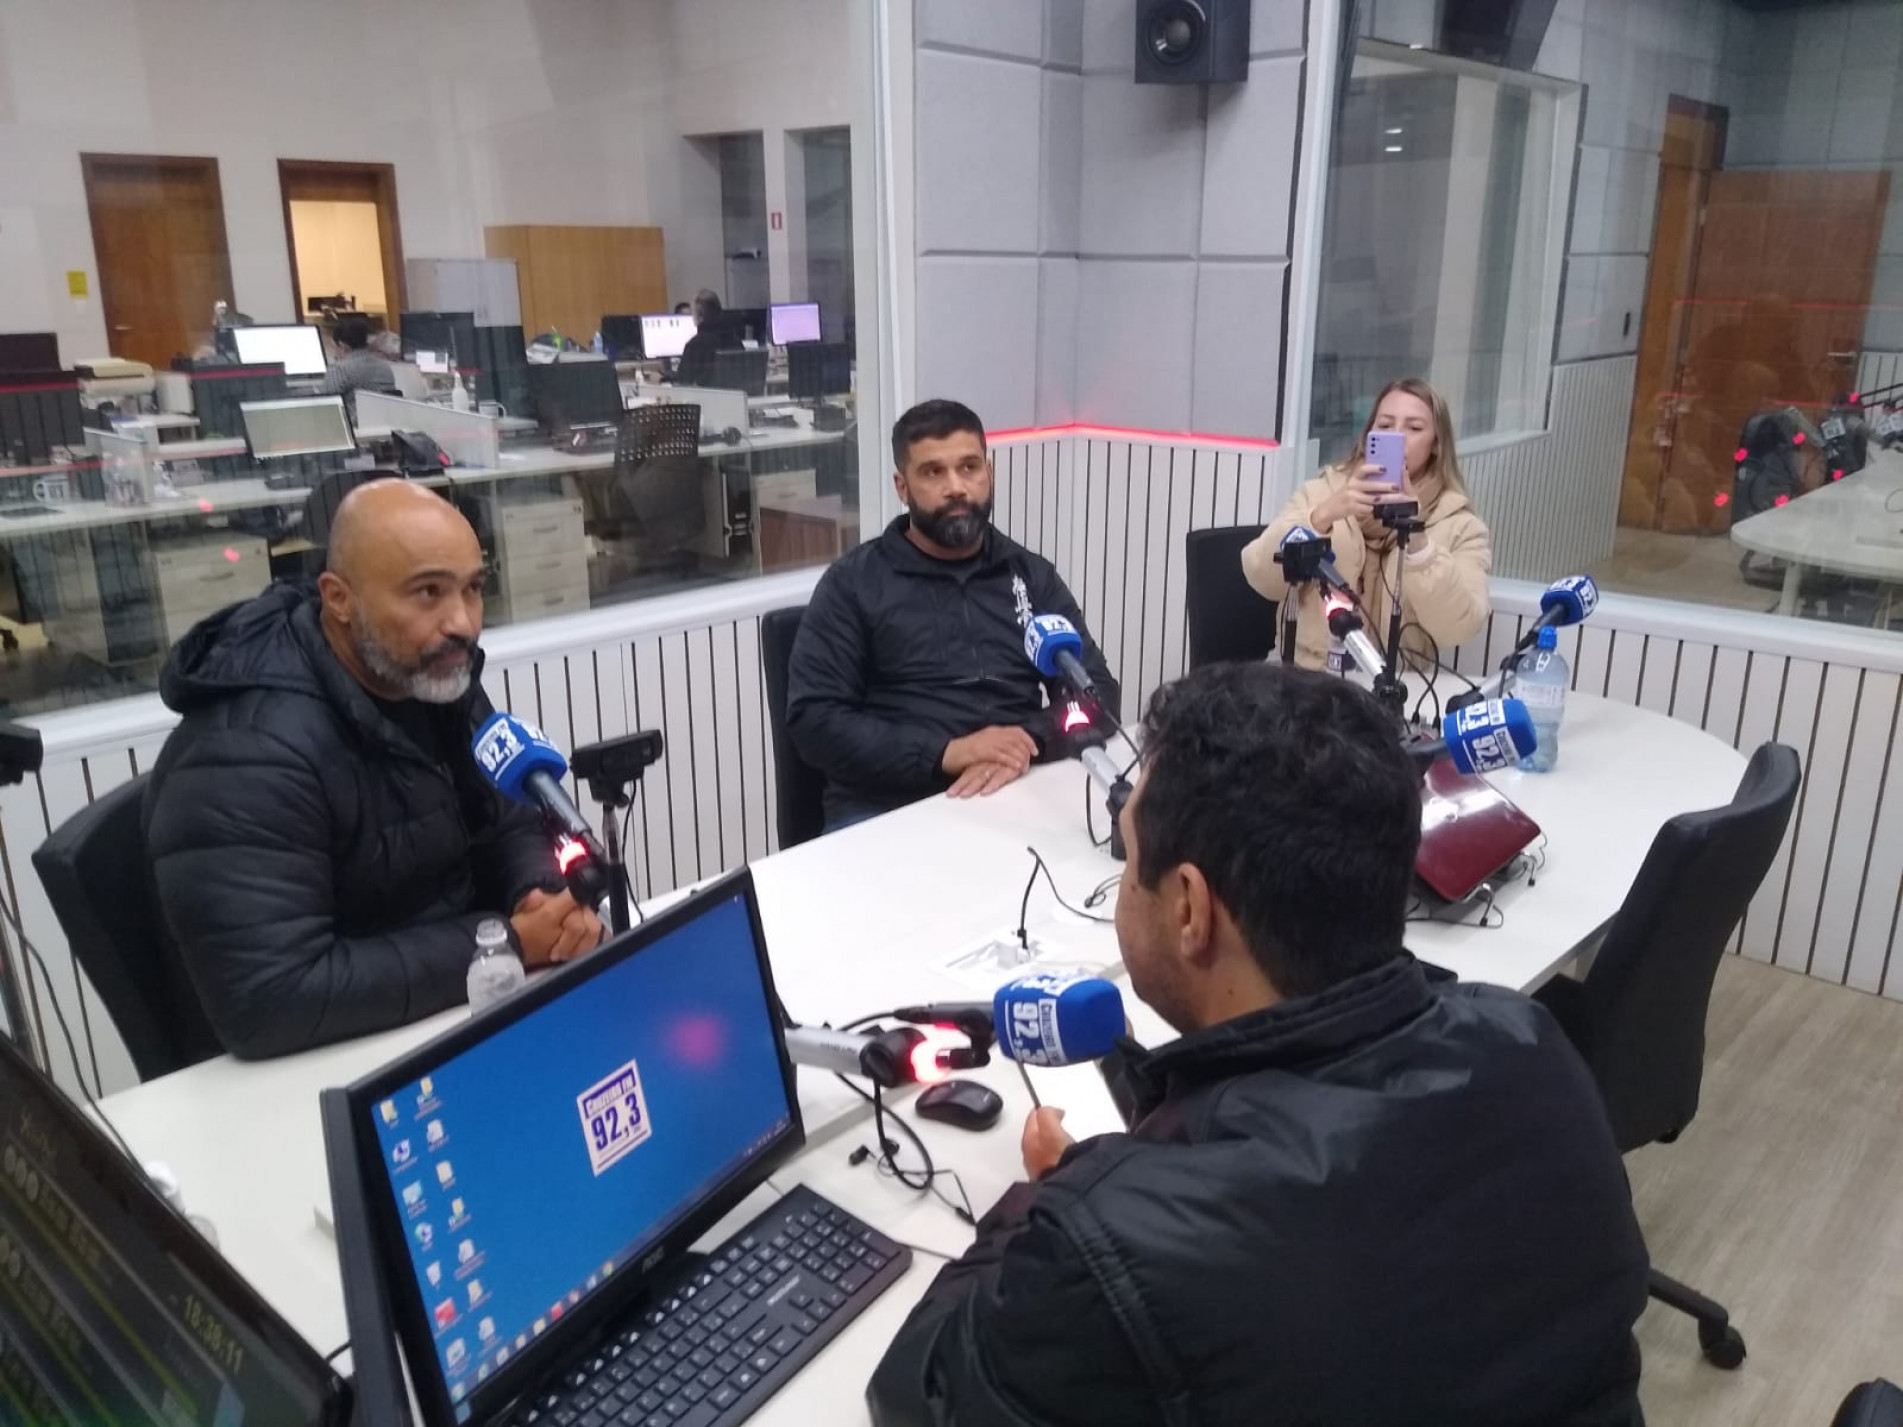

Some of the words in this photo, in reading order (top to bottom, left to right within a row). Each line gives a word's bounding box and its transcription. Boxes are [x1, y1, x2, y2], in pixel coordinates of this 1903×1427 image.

[1472, 734, 1506, 772] 92,3
[1013, 1001, 1049, 1066] 92,3
[591, 1092, 641, 1151] 92,3
